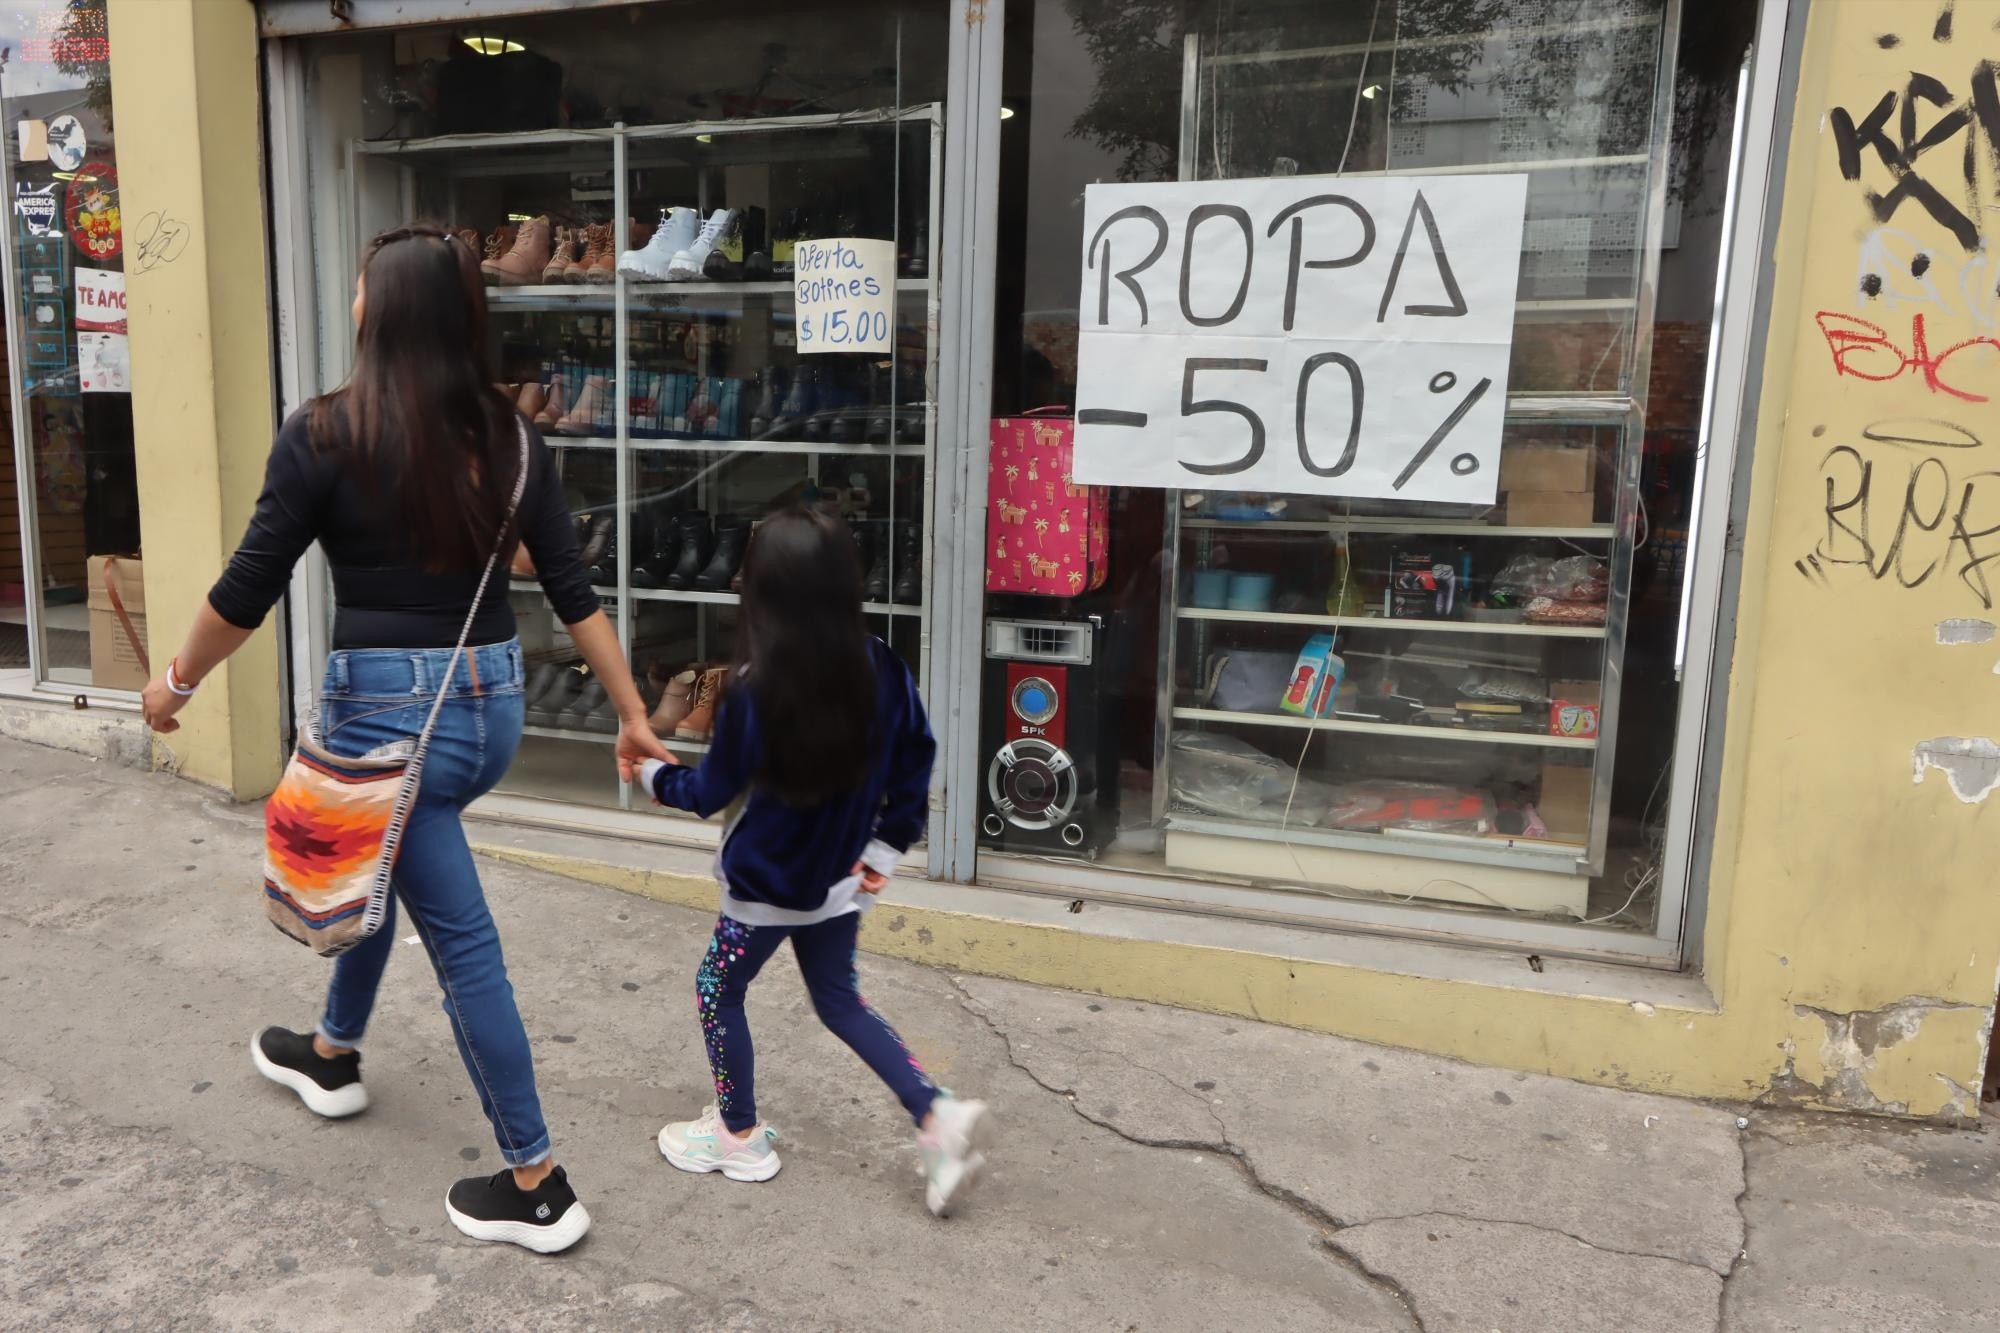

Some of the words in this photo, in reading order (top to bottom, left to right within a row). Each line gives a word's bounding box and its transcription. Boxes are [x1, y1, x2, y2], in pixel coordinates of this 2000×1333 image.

[799, 240, 864, 272] Oferta
[1087, 189, 1469, 332] ROPA
[78, 286, 95, 306] TE
[1021, 726, 1046, 736] SPK
